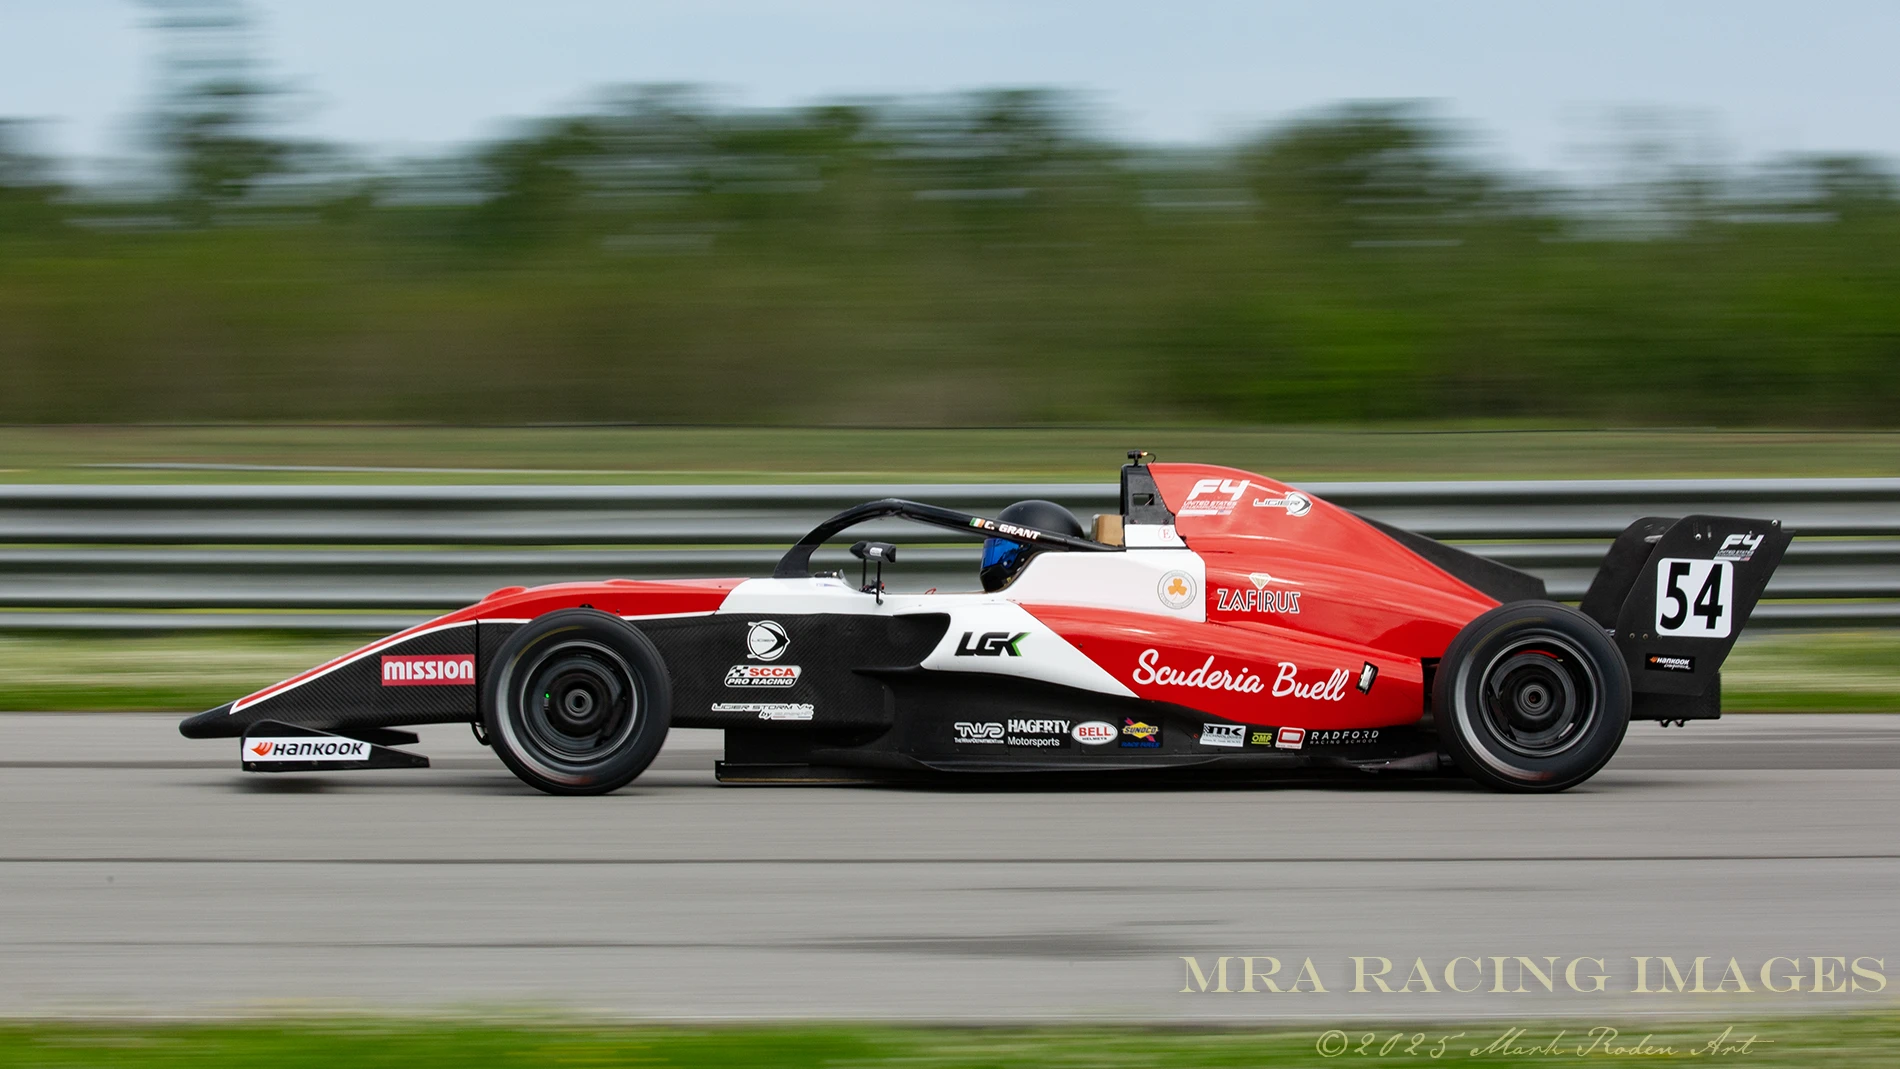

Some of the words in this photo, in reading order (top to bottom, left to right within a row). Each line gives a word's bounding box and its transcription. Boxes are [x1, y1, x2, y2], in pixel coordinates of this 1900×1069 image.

[1186, 479, 1250, 501] F4
[984, 521, 995, 530] C.
[999, 523, 1041, 540] GRANT
[1720, 534, 1764, 550] F4
[1216, 588, 1301, 614] ZAFIRUS
[1659, 561, 1724, 631] 54
[954, 631, 1031, 657] LGK
[749, 667, 796, 677] SCCA
[1132, 649, 1264, 693] Scuderia
[1272, 661, 1350, 702] Buell
[1007, 719, 1070, 734] HAGERTY
[1079, 726, 1112, 737] BELL
[1124, 726, 1157, 734] SUNOCO
[1007, 736, 1060, 747] Motorsports
[1251, 734, 1272, 743] OMP
[1311, 730, 1379, 740] RADFORD
